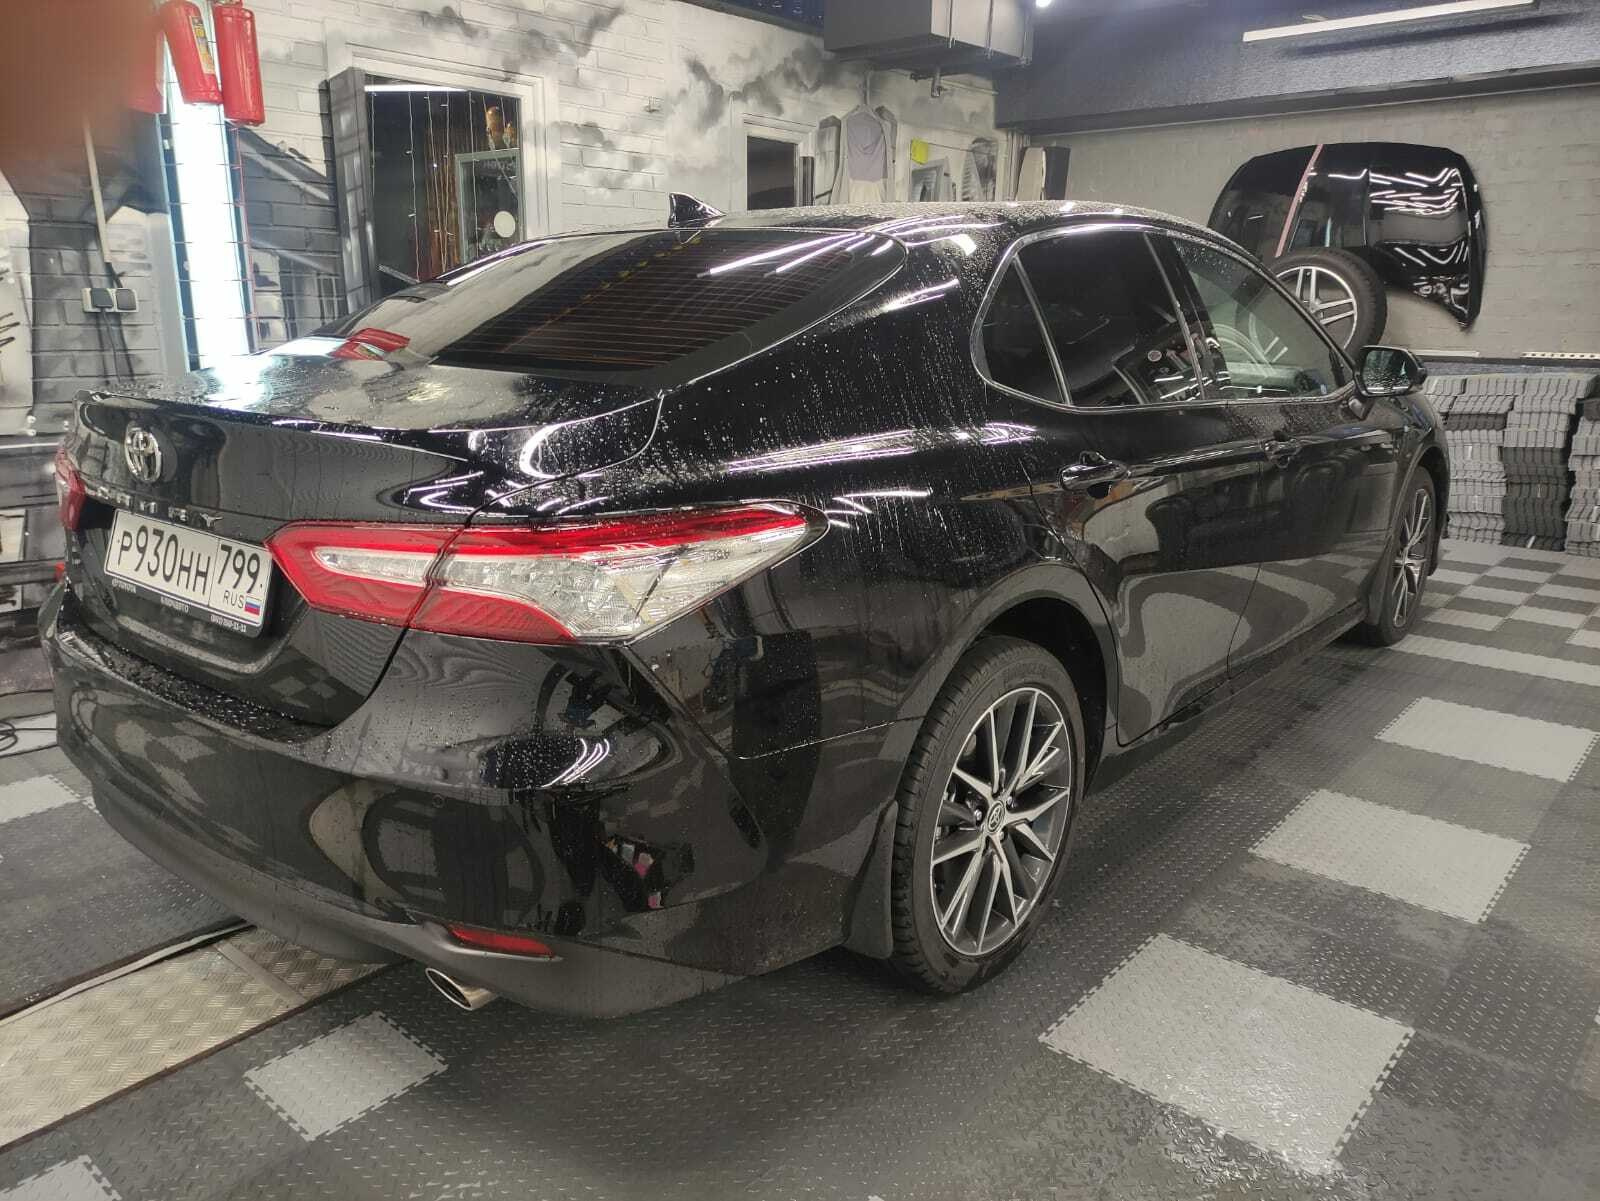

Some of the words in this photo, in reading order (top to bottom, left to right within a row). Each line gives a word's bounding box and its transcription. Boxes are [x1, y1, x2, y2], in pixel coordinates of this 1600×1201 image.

[118, 524, 211, 596] Р930НН
[217, 544, 261, 594] 799
[223, 590, 244, 609] RUS
